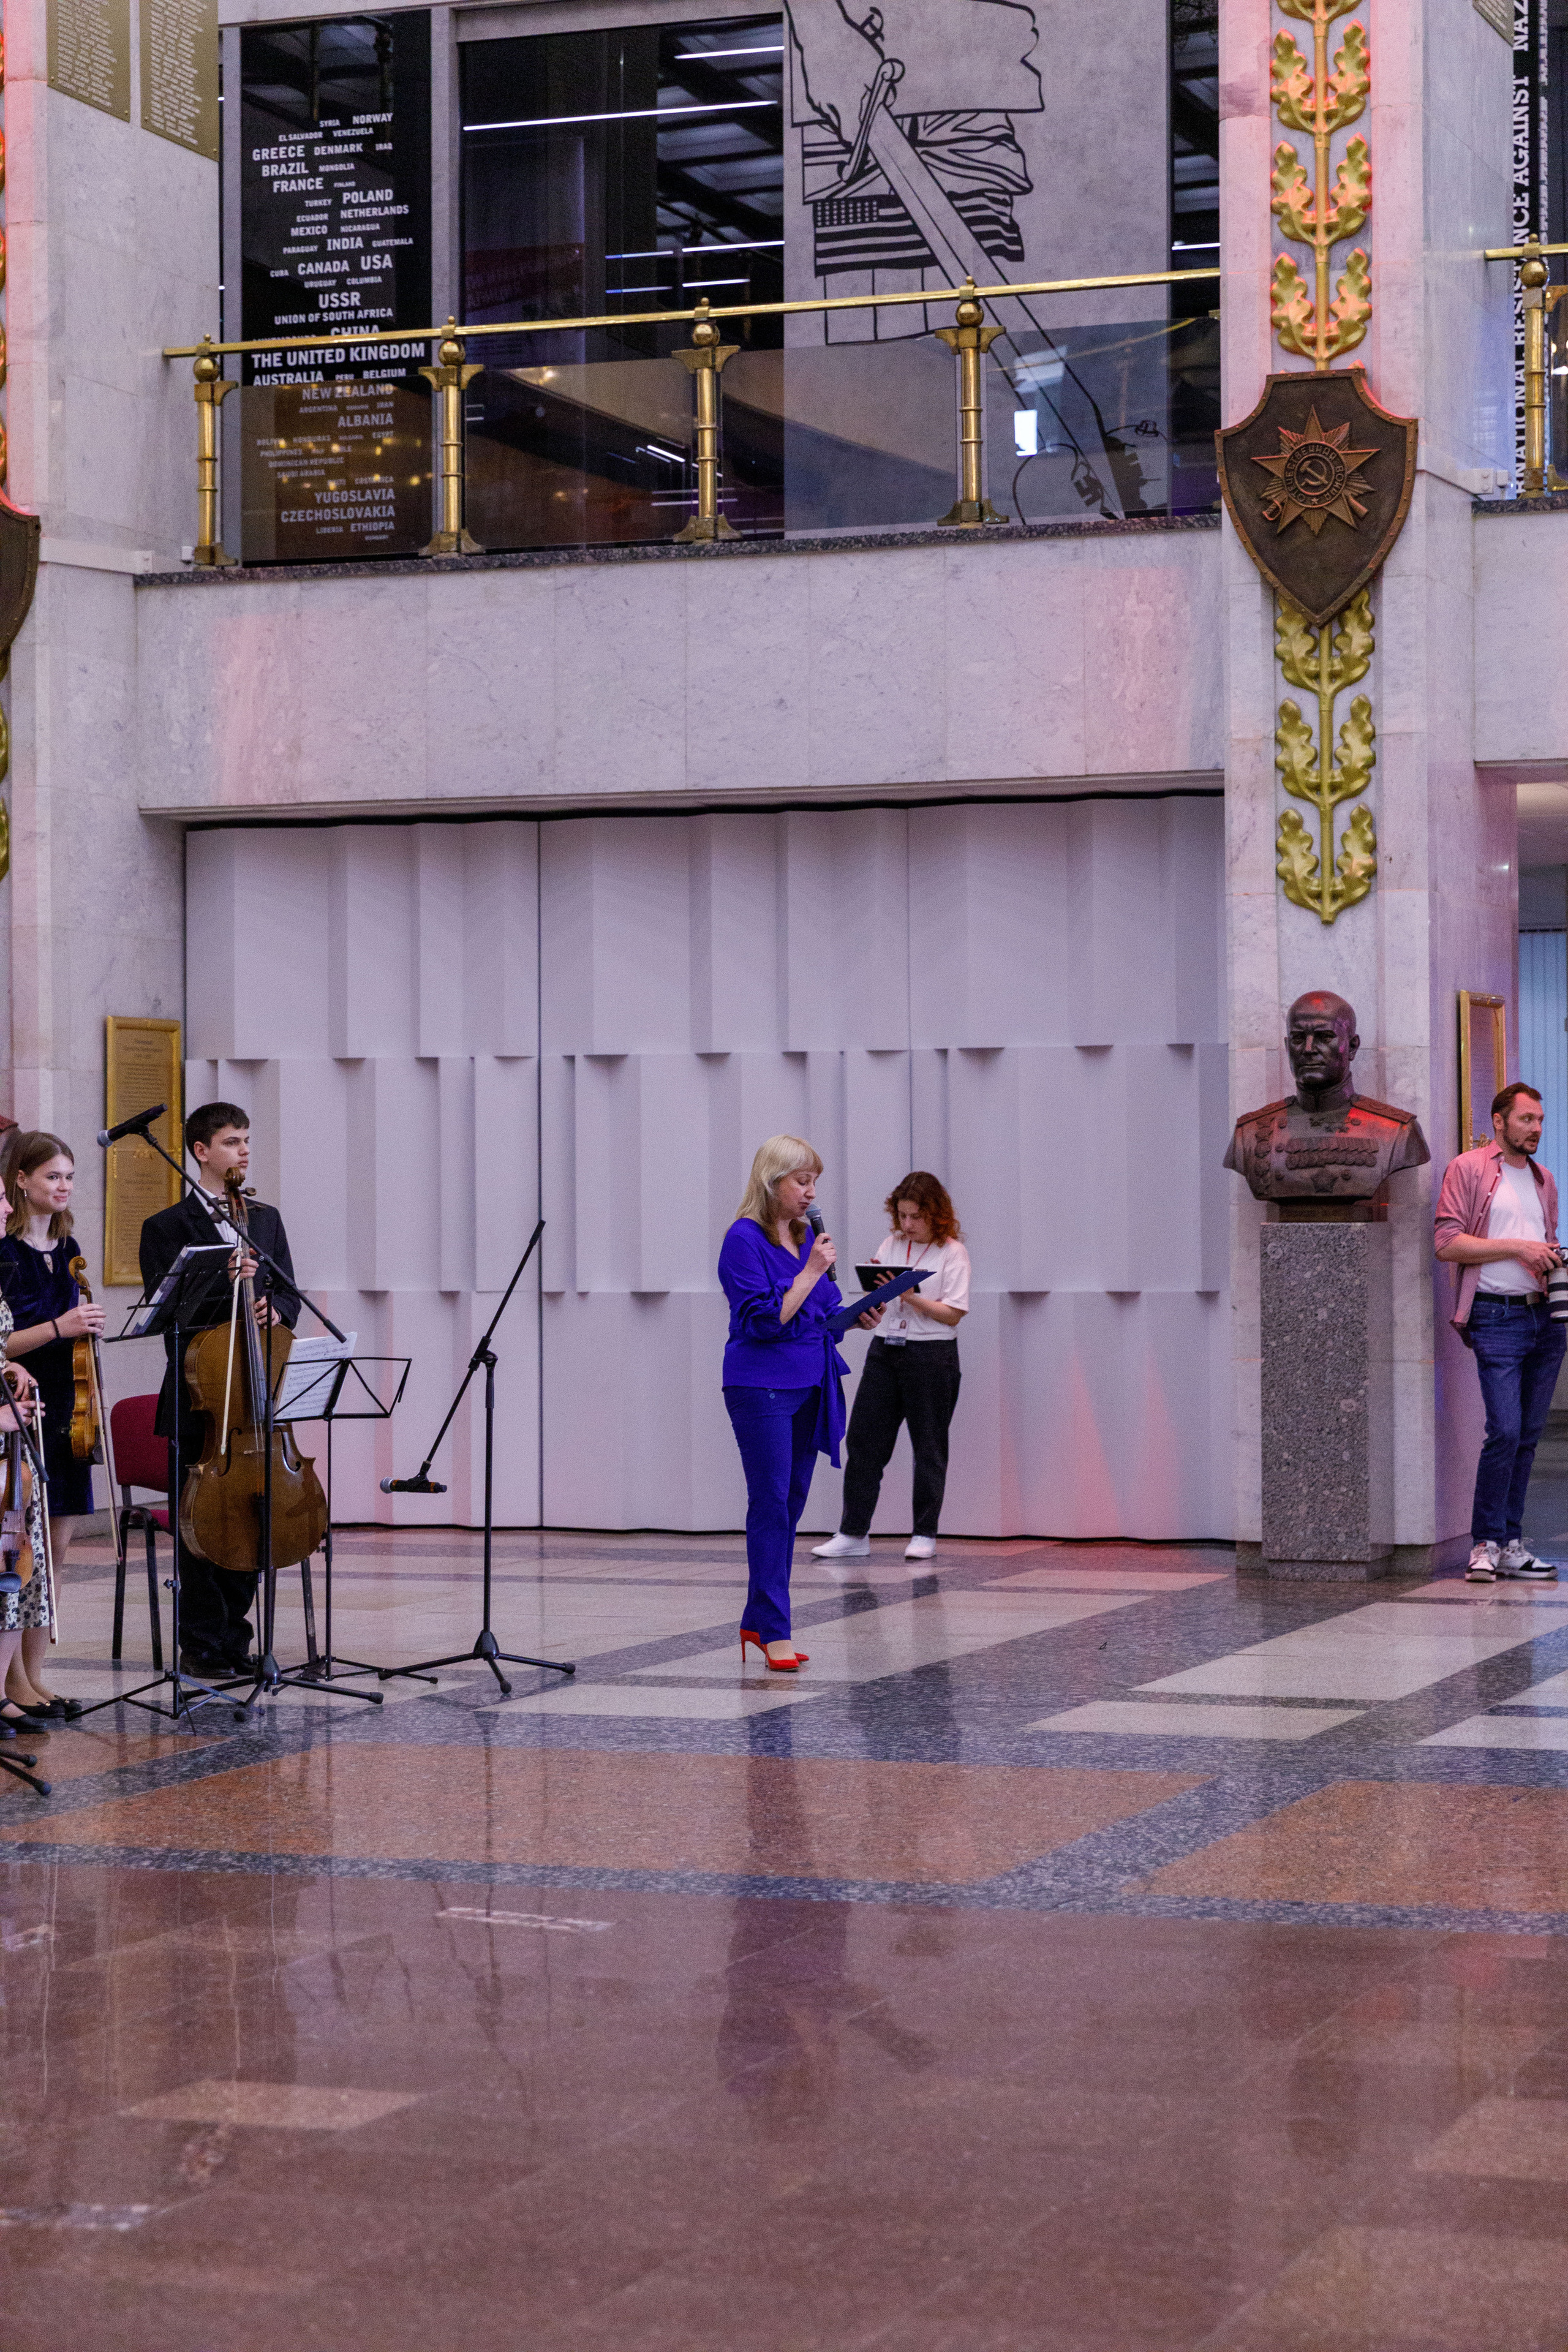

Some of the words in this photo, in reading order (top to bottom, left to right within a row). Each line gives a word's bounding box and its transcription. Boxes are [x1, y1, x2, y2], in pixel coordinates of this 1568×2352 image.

[319, 119, 341, 127] SYRIA
[352, 113, 393, 125] NORWAY
[288, 131, 323, 141] SALVADOR
[333, 127, 374, 137] VENEZUELA
[1513, 75, 1529, 186] AGAINST
[252, 145, 305, 161] GREECE
[314, 143, 363, 156] DENMARK
[262, 162, 309, 177] BRAZIL
[318, 163, 355, 172] MONGOLIA
[273, 177, 324, 193] FRANCE
[305, 198, 332, 207] TURKEY
[342, 189, 393, 205] POLAND
[296, 213, 329, 222] ECUADOR
[340, 205, 409, 219] NETHERLANDS
[290, 225, 328, 236] MEXICO
[340, 223, 380, 233] NICARAGUA
[282, 245, 318, 254] PARAGUAY
[326, 236, 364, 251] INDIA
[372, 238, 413, 247] GUATEMALA
[298, 260, 350, 275] CANADA
[360, 254, 393, 270] USA
[1513, 193, 1530, 345] RESISTNCE
[304, 279, 337, 288] URUGUAY
[318, 292, 361, 309] USSR
[274, 314, 306, 325] UNION
[308, 313, 321, 323] OF
[322, 310, 355, 322] SOUTH
[356, 308, 393, 319] AFRICA
[251, 352, 283, 368] THE
[287, 348, 345, 366] UNITED
[349, 342, 425, 362] KINGDOM
[253, 370, 324, 386] AUSTRALIA
[335, 373, 355, 382] PERU
[363, 368, 407, 379] BELGIUM
[302, 388, 331, 401] NEW
[334, 383, 393, 398] ZEALAND
[337, 413, 394, 428] ALBANIA
[314, 488, 395, 504] YUGOSLAVIA
[281, 505, 395, 522] CZECHOSLOVAKIA
[350, 521, 394, 532] ETHIOPIA
